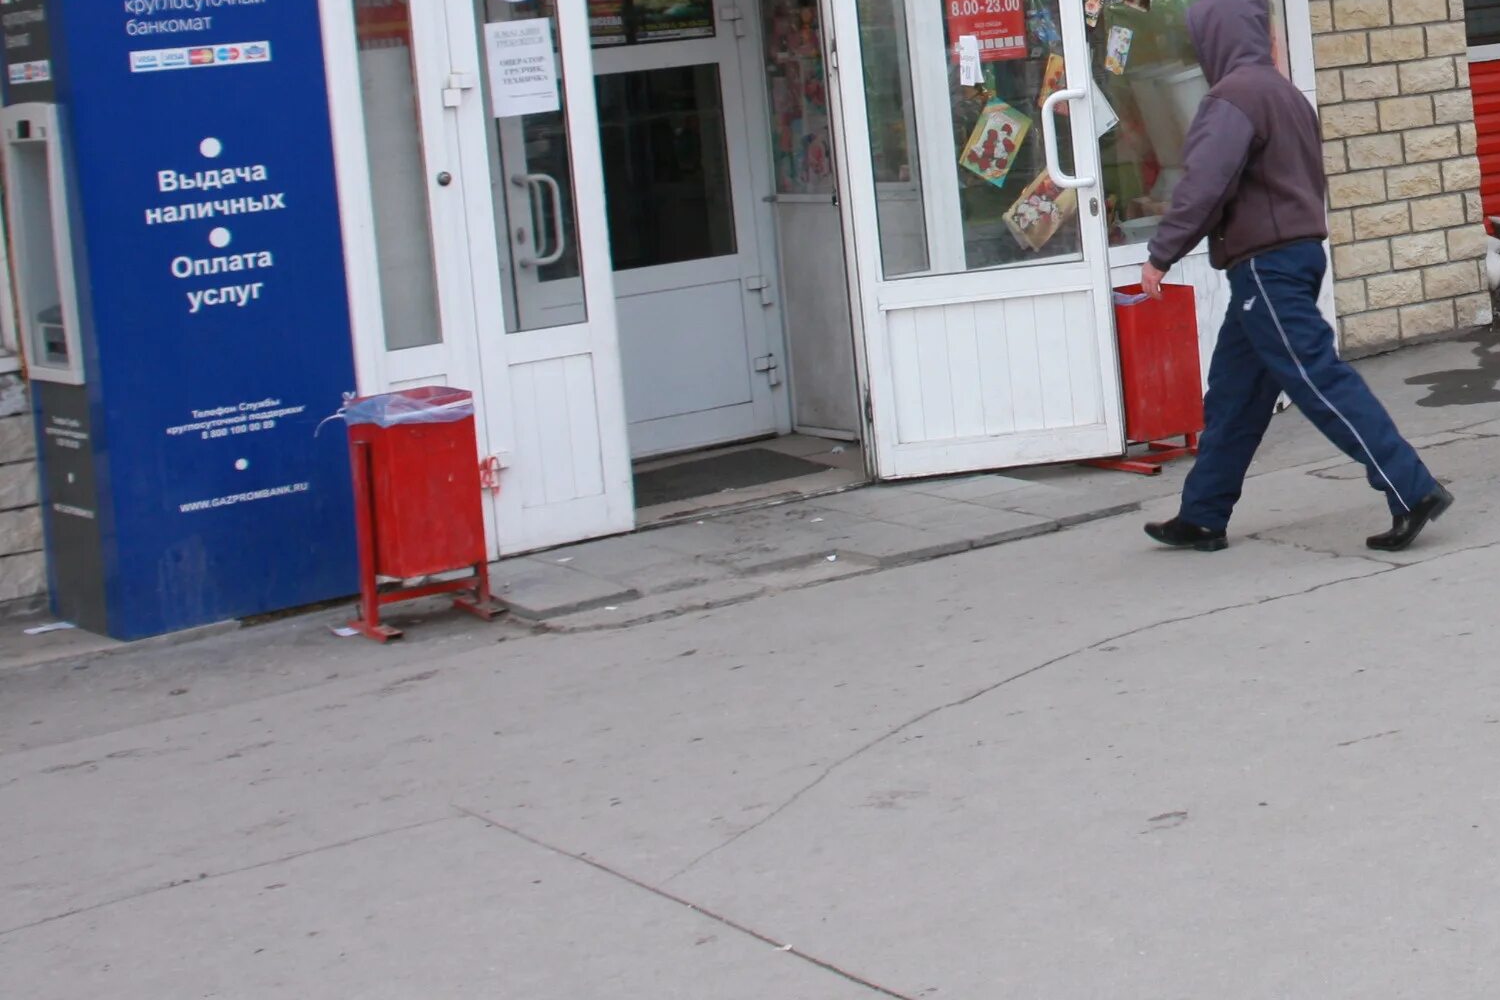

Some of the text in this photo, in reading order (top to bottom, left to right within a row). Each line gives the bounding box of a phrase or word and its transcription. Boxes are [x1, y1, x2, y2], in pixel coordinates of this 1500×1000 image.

[126, 14, 213, 36] банкомат
[158, 163, 267, 192] Выдача
[145, 193, 286, 225] наличных
[170, 249, 273, 279] Оплата
[187, 280, 264, 313] услуг
[192, 398, 281, 419] Телефон Службы
[166, 414, 247, 435] круглосуточной
[180, 482, 310, 513] WWW.GAZPROMBANK.RU
